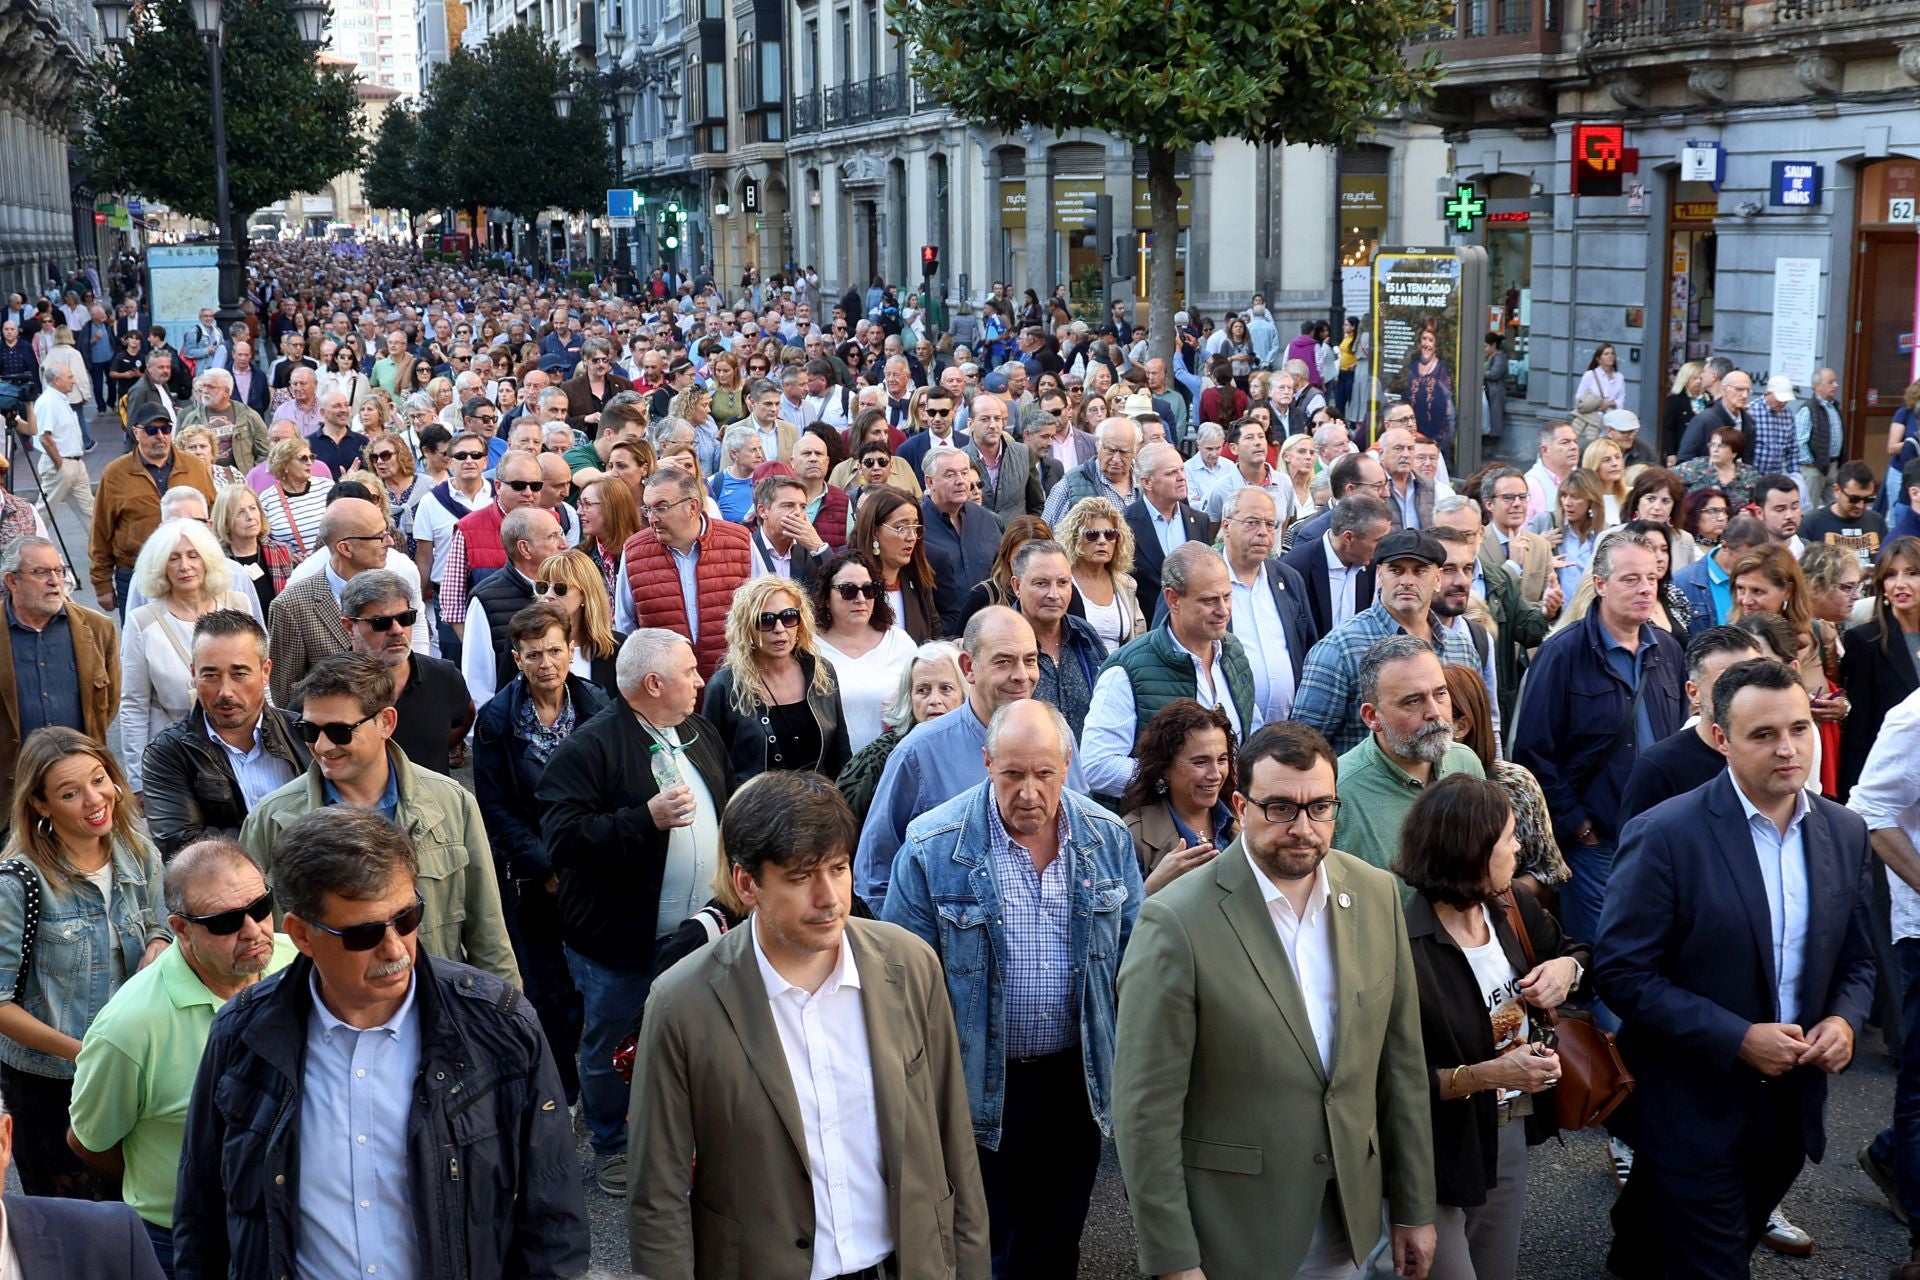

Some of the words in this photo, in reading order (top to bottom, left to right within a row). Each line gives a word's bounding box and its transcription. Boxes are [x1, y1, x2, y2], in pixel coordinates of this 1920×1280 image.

[1784, 165, 1812, 178] SALON
[1792, 178, 1803, 189] DE
[1782, 190, 1811, 204] UÑAS
[1892, 202, 1911, 219] 62
[1385, 283, 1395, 293] ES
[1395, 283, 1406, 293] LA
[1407, 283, 1451, 294] TENACIDAD
[1389, 295, 1400, 306] DE
[1400, 294, 1425, 306] MARÍA
[1426, 295, 1447, 307] JOSÉ
